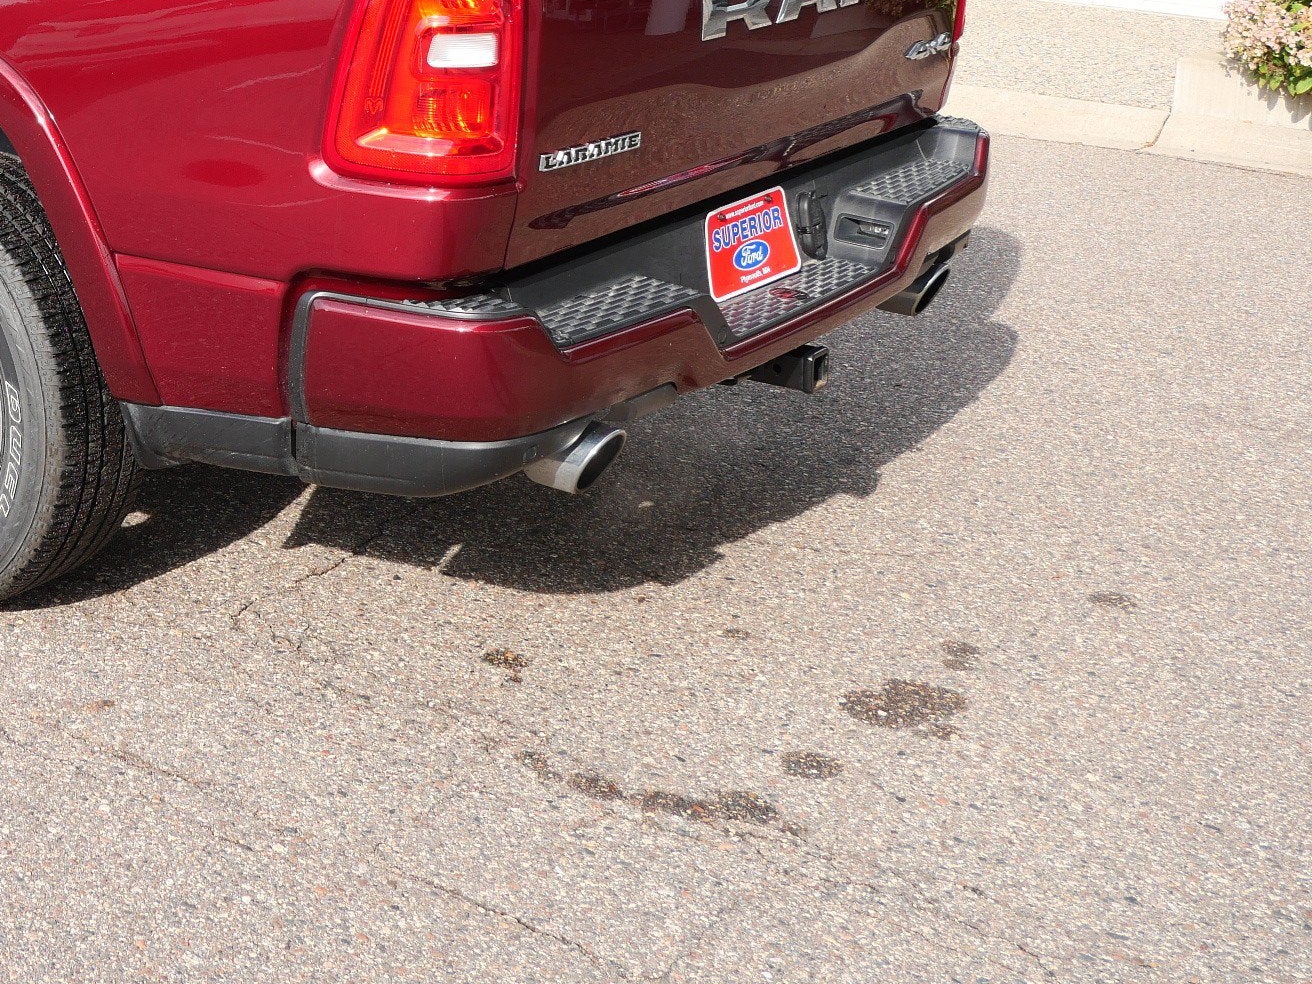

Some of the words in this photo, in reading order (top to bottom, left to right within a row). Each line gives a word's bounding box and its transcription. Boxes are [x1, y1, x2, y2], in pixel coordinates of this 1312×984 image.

[539, 131, 642, 172] LARAMIE
[713, 206, 783, 252] SUPERIOR
[741, 244, 763, 265] Ford
